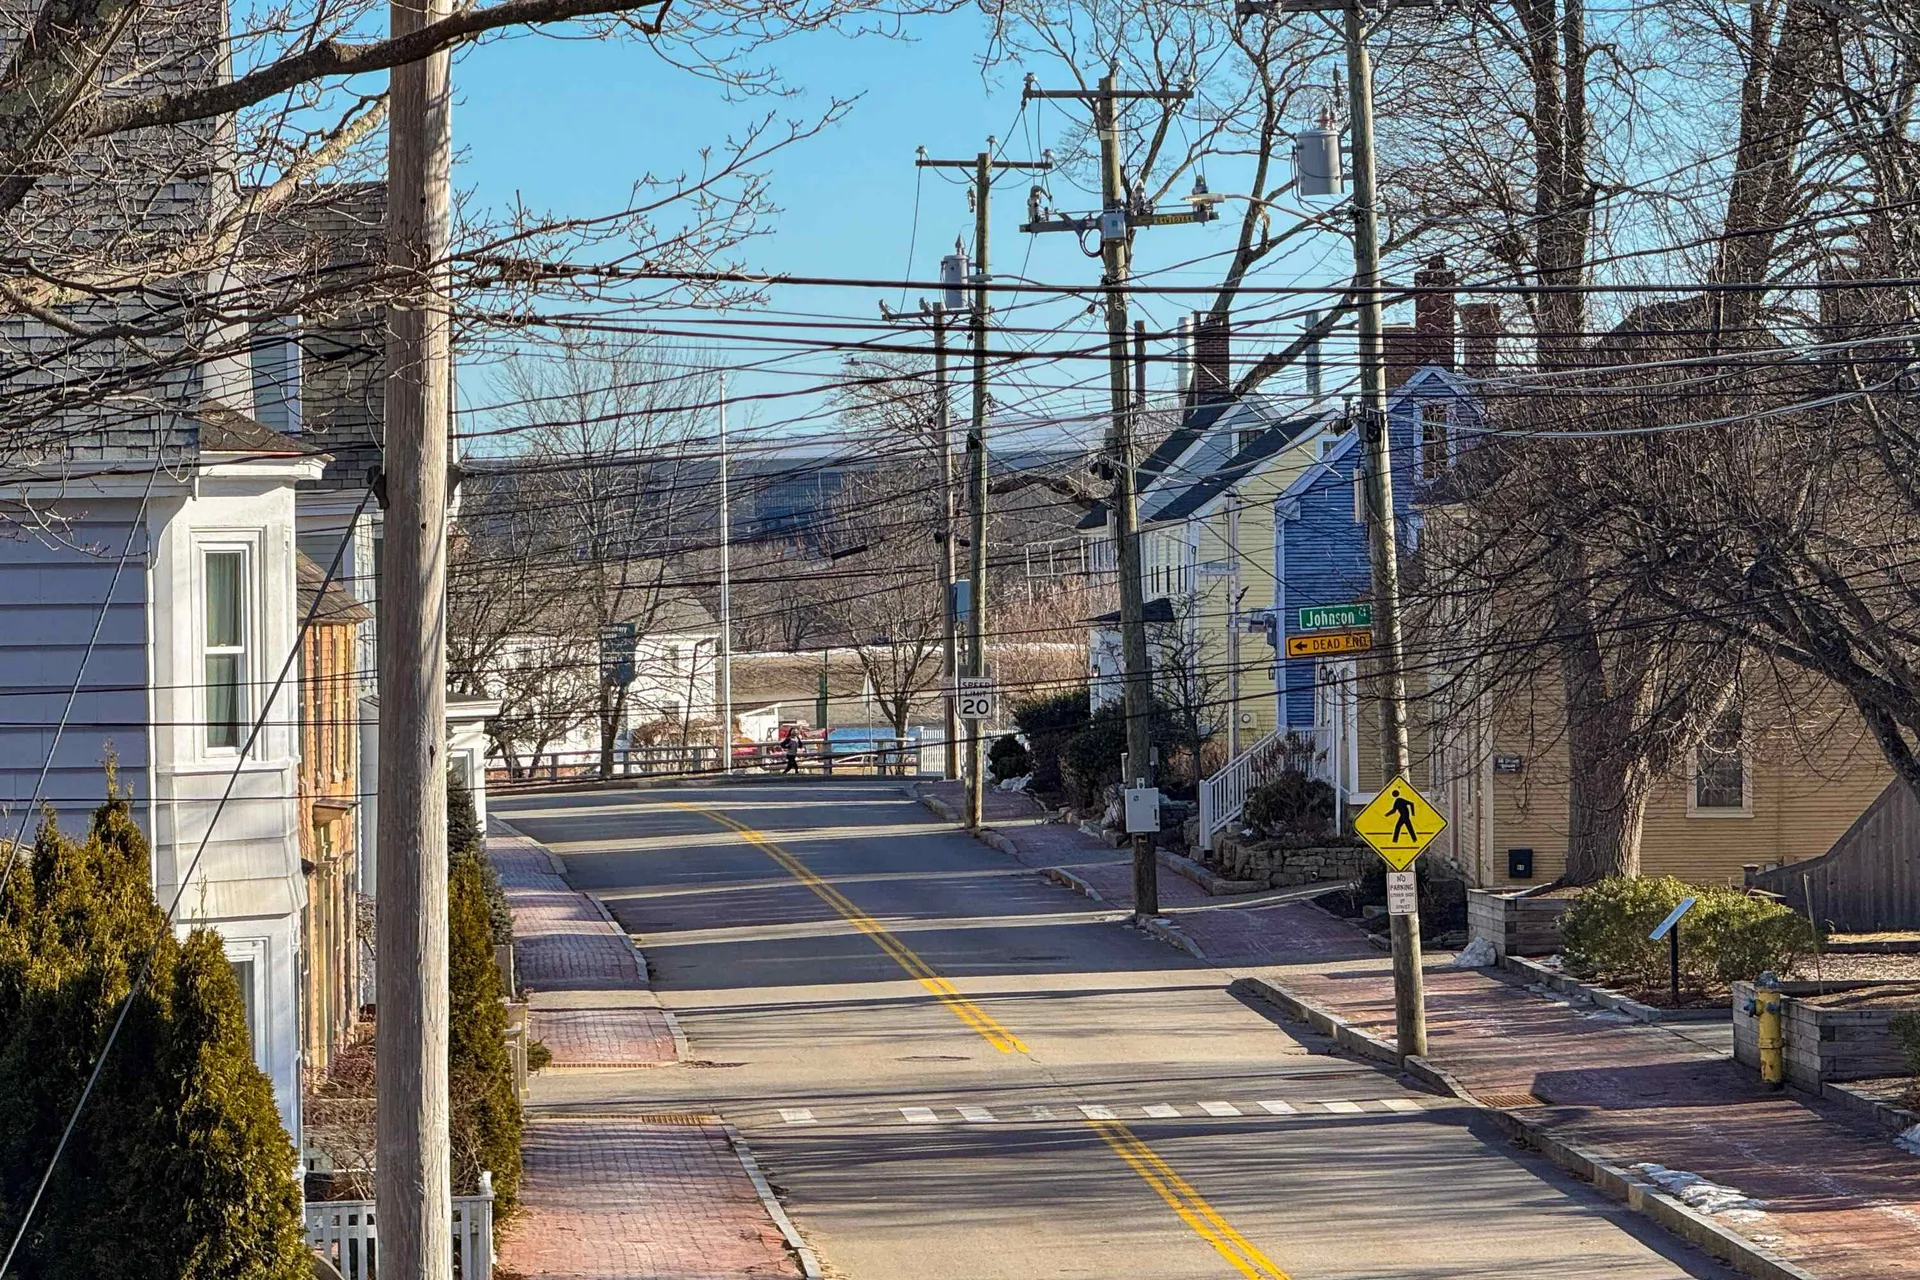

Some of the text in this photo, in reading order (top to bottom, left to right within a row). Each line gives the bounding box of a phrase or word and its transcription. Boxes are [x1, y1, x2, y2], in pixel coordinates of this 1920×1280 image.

[1306, 610, 1355, 627] Johnson
[1313, 635, 1368, 651] DEAD END
[962, 681, 990, 689] SPEED
[962, 699, 989, 715] 20
